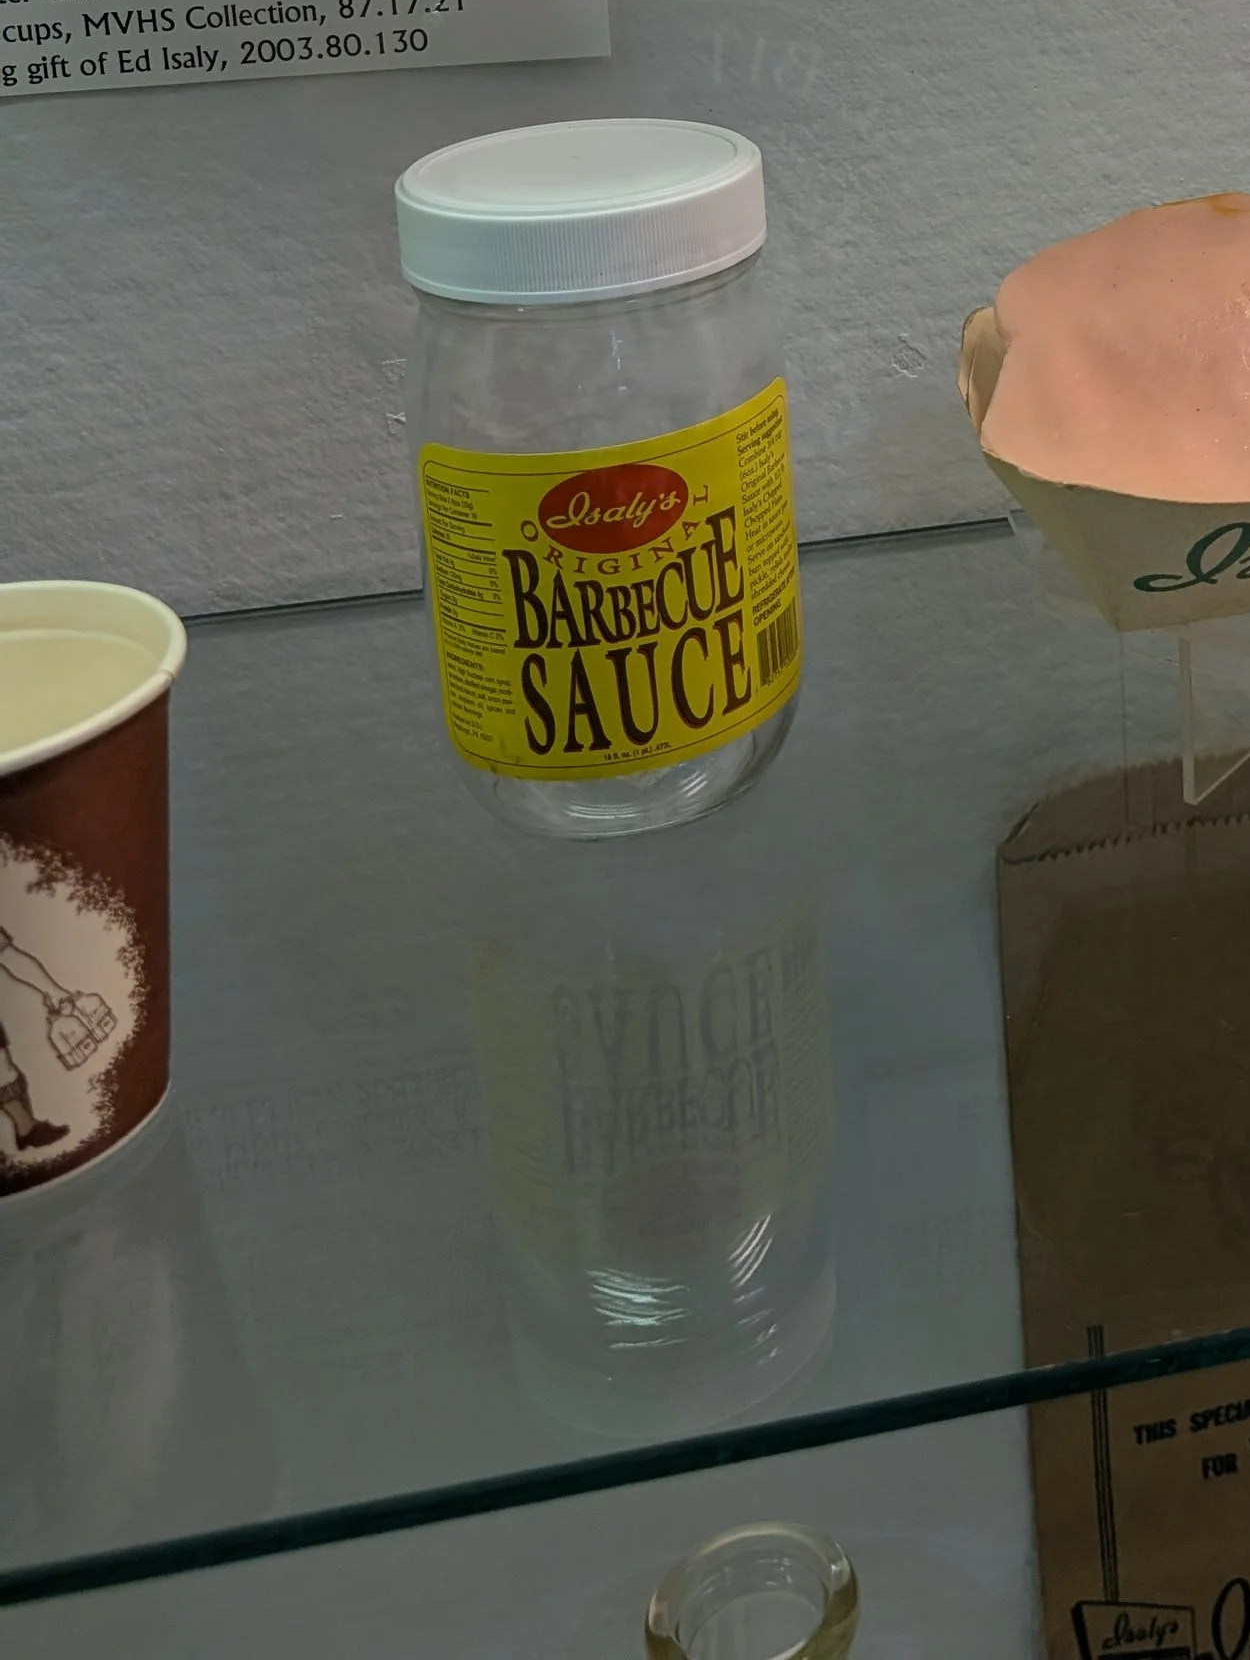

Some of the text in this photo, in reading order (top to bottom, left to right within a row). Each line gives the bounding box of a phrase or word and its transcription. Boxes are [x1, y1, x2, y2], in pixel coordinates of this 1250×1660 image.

[2, 22, 72, 46] cups,
[81, 7, 176, 37] MVHS
[185, 0, 326, 30] Collection,
[27, 28, 428, 85] gift of Ed Isaly, 2003.80.130
[520, 484, 710, 575] ORIGINAL
[546, 487, 681, 531] Isaly's
[502, 506, 744, 649] BARBECUE
[520, 610, 753, 755] SAUCE
[1133, 1418, 1177, 1444] THIS
[1202, 1453, 1237, 1480] FOR
[1102, 1612, 1179, 1649] Isaly's
